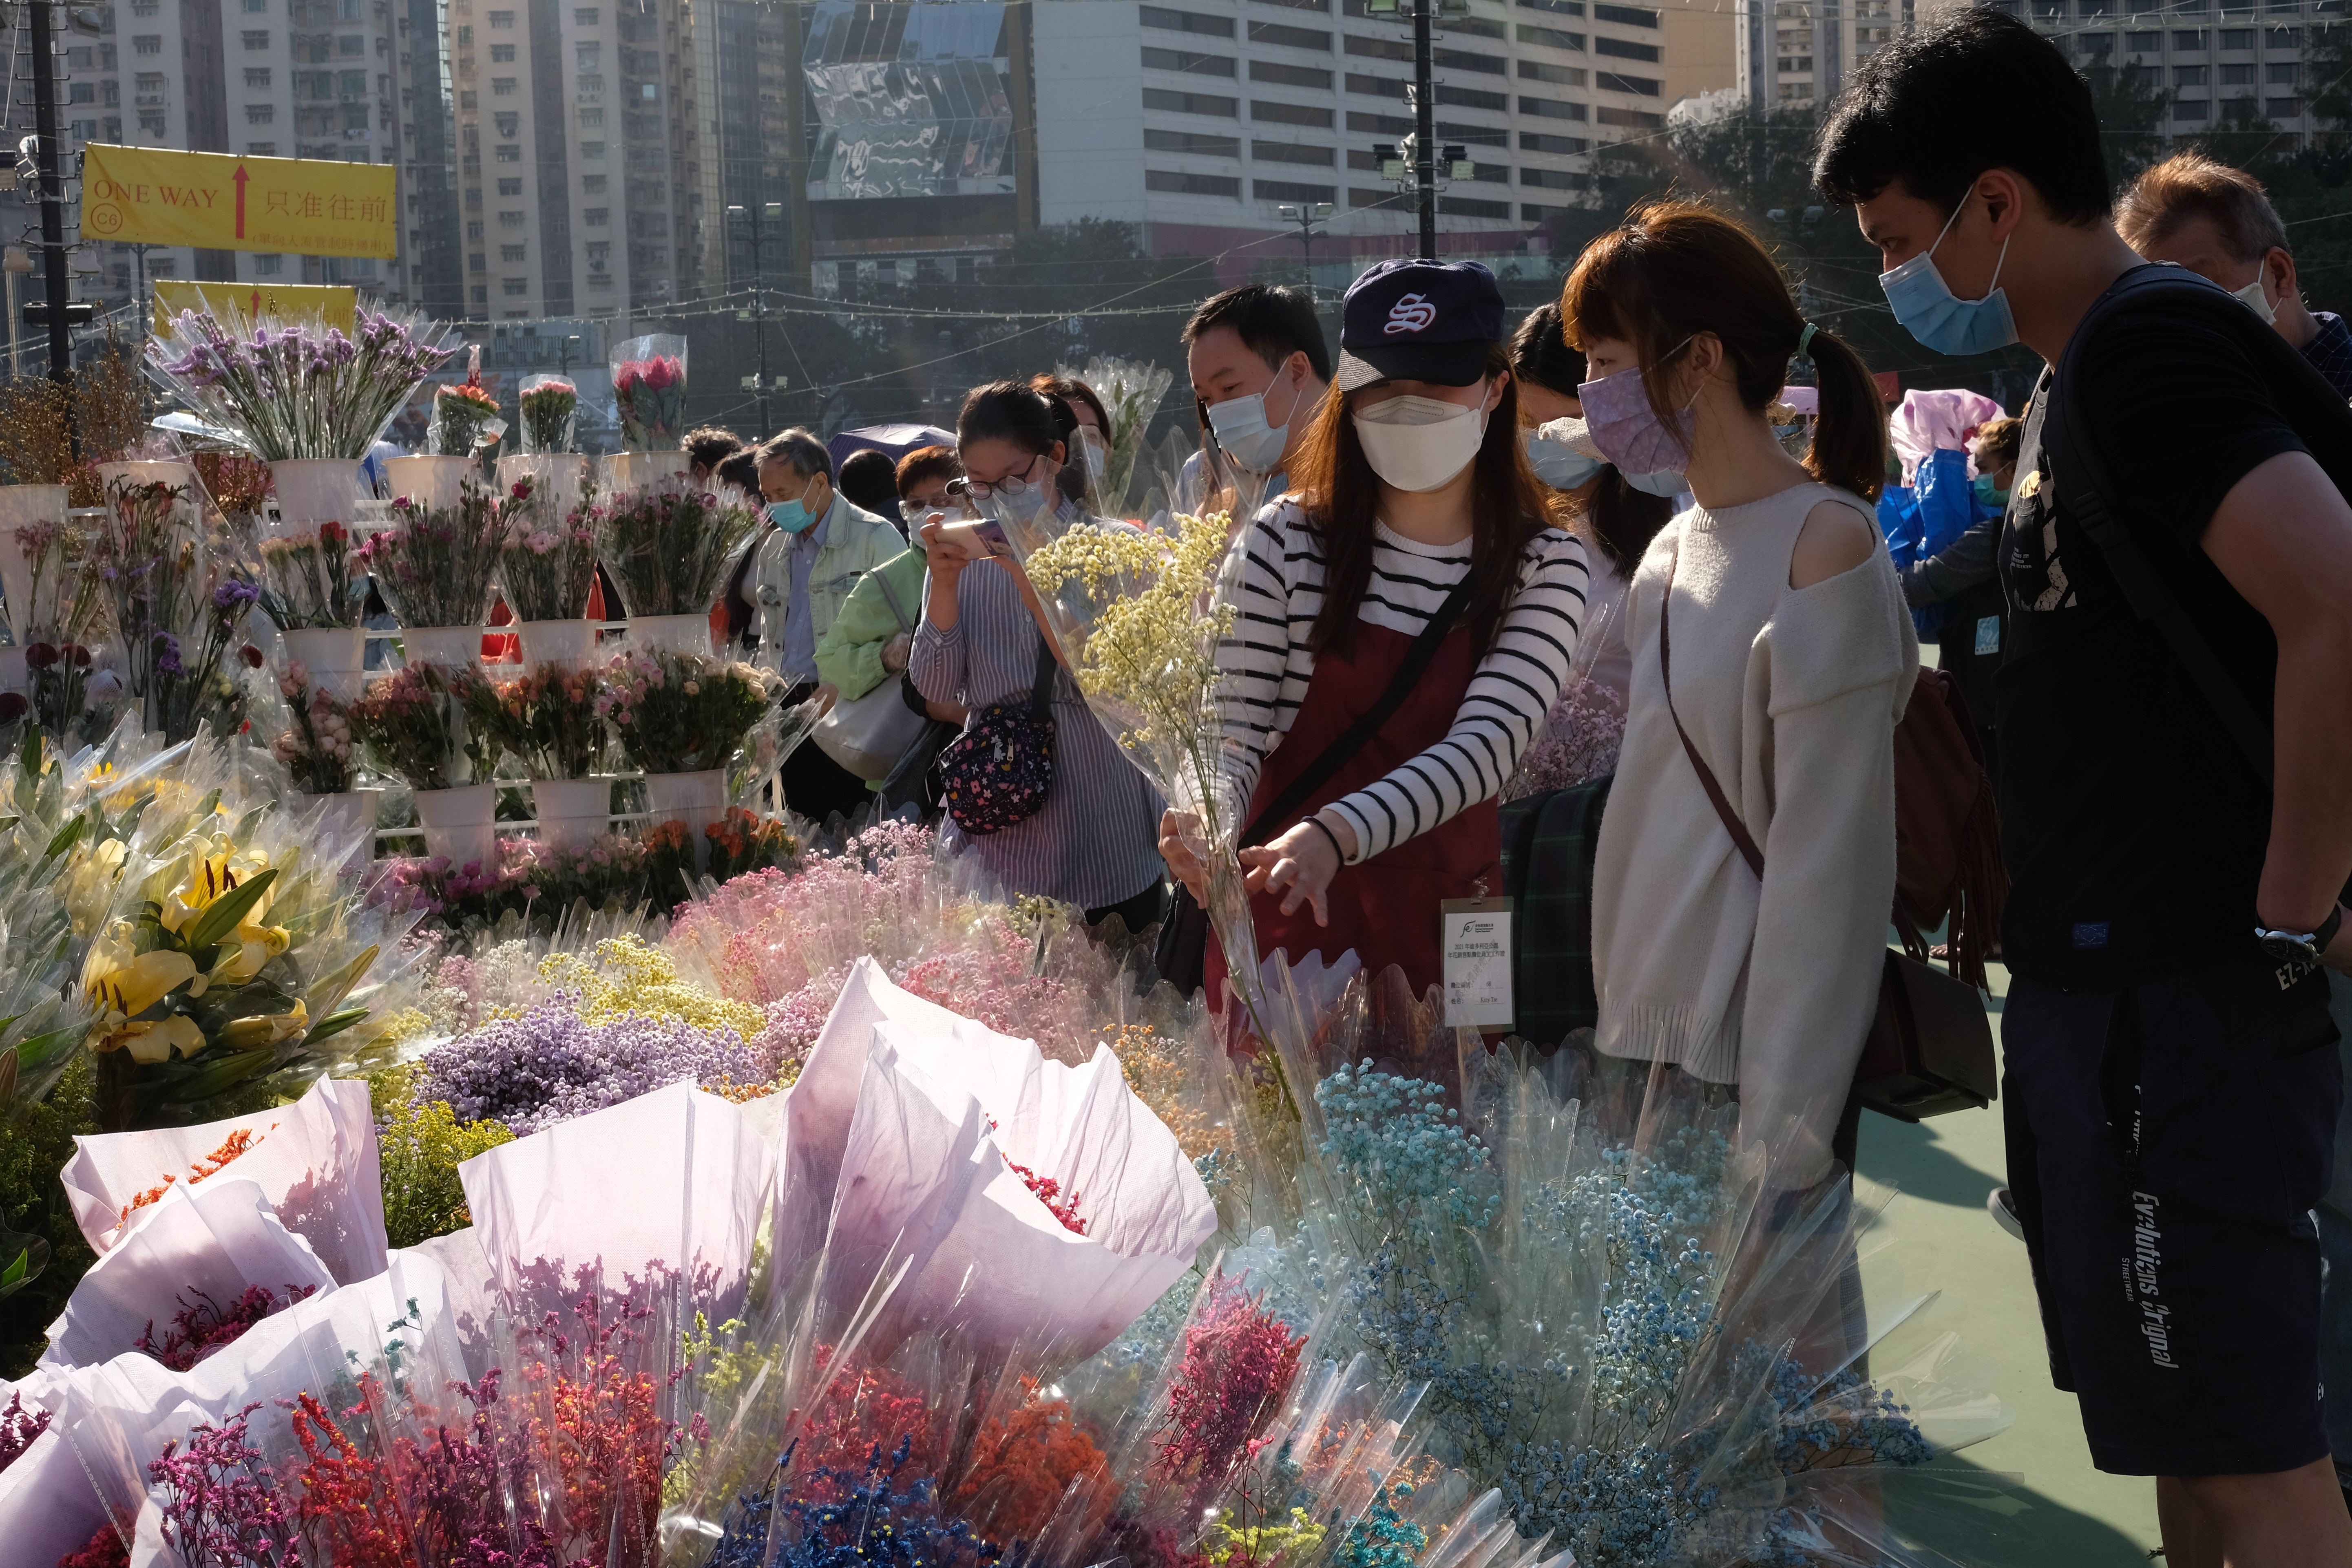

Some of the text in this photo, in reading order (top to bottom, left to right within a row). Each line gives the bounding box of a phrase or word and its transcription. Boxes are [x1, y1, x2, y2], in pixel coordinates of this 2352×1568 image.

[94, 180, 219, 208] ONE WAY
[265, 191, 386, 222] 只准往前
[97, 213, 117, 225] C6
[2122, 1258, 2134, 1302] STREETWEAR
